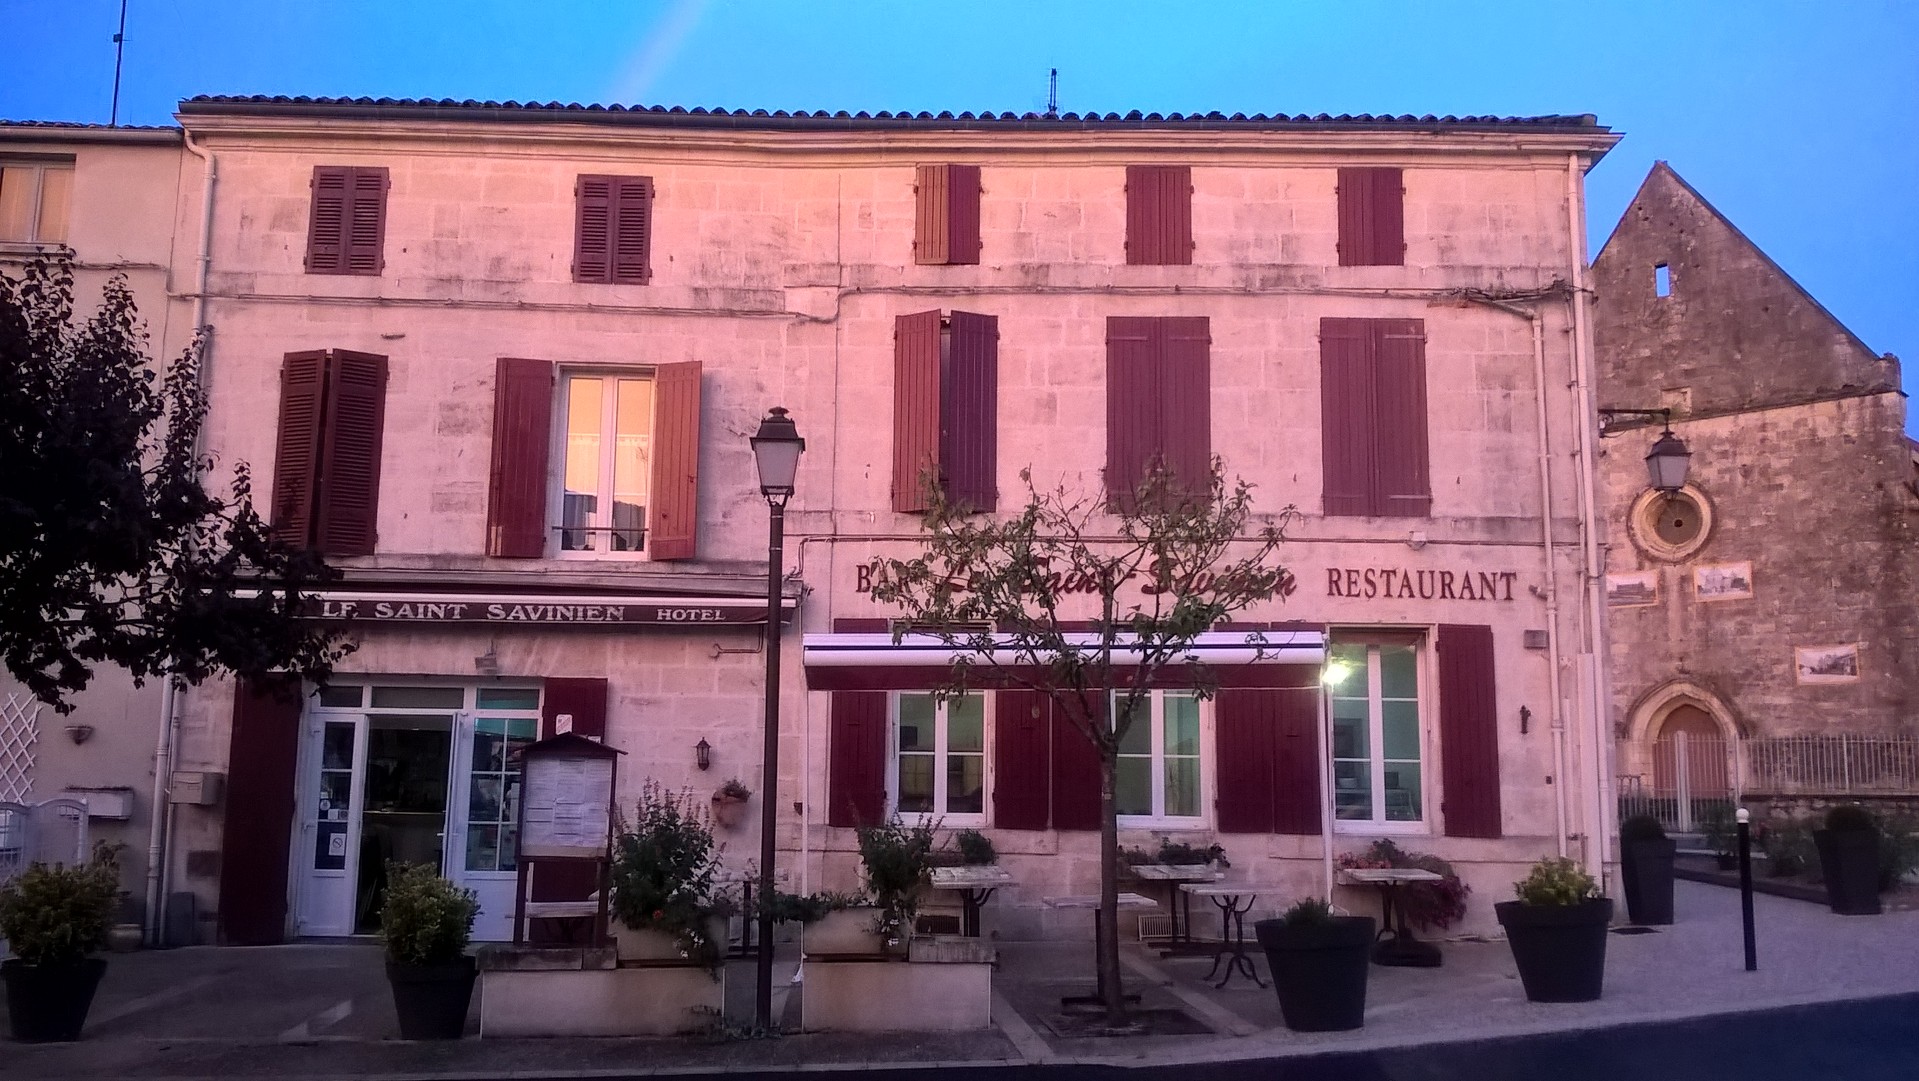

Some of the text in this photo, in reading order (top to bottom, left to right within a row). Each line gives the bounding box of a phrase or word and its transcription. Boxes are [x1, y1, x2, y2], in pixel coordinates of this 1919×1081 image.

[1326, 567, 1518, 601] RESTAURANT
[322, 601, 727, 621] LE SAINT SAVINIEN HOTEL
